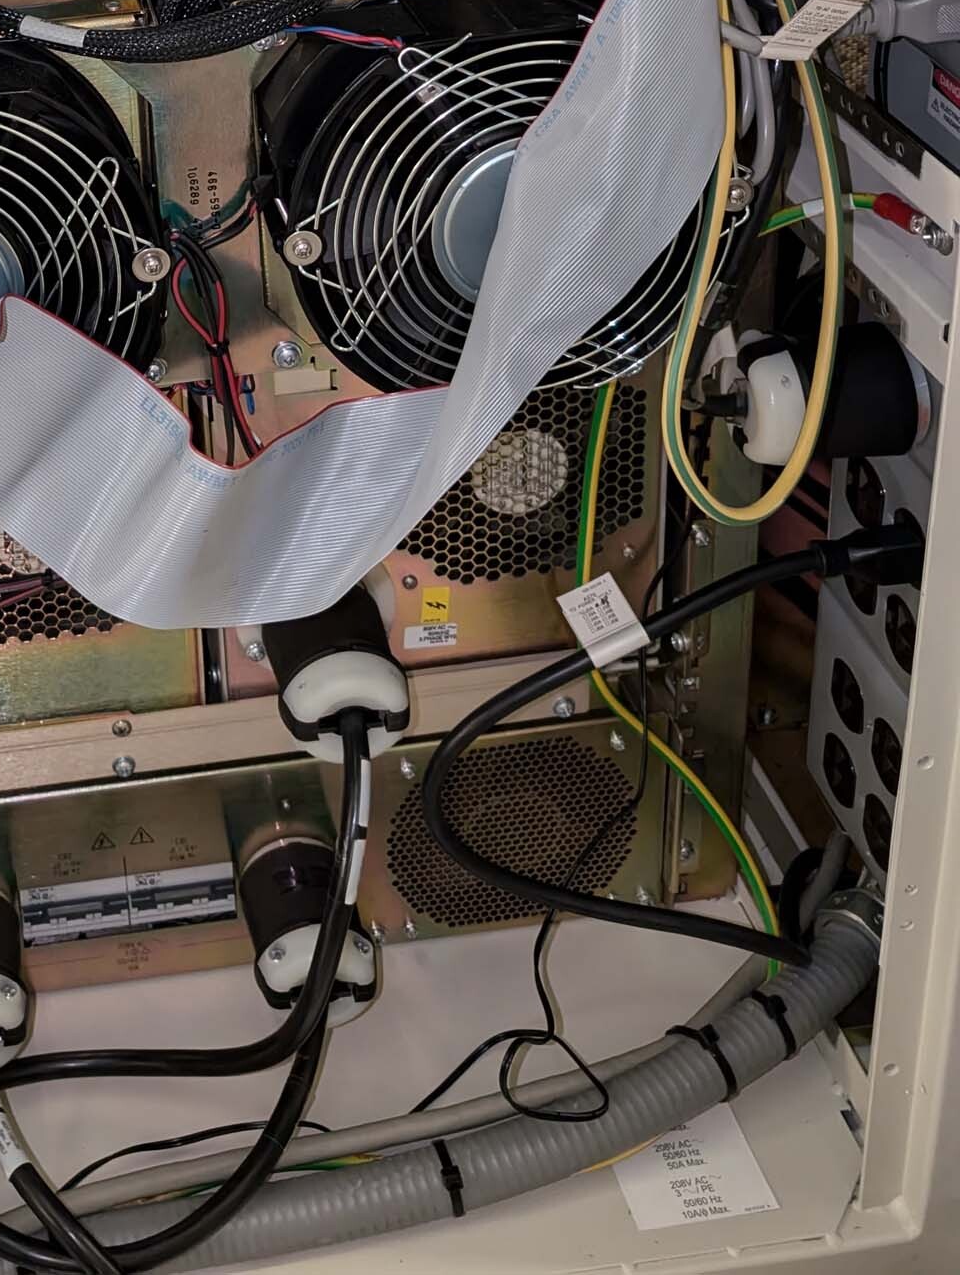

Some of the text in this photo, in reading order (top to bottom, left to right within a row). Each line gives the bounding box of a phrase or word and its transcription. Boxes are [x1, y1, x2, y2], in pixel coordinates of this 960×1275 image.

[188, 167, 200, 206] 106289
[688, 1148, 701, 1156] Hz
[667, 1160, 686, 1170] 50A
[669, 1179, 692, 1190] 208V
[683, 1195, 723, 1208] 50/60 Hz
